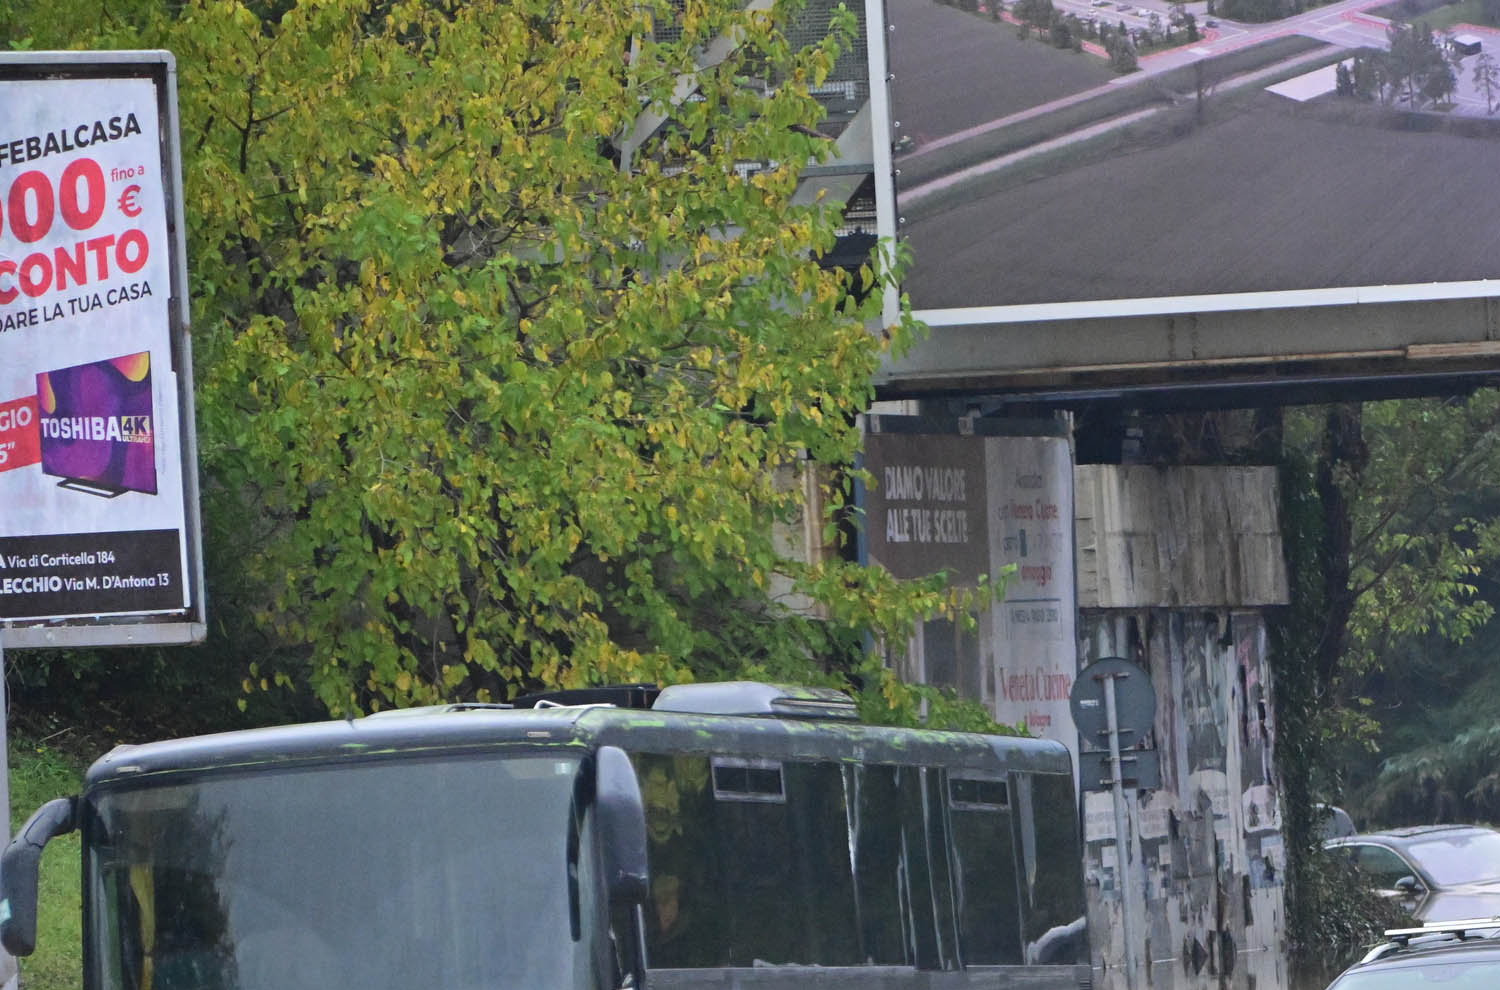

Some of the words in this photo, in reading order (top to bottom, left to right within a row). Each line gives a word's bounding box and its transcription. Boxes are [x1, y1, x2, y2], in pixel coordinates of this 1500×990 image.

[0, 112, 142, 168] FEBALCASA
[110, 167, 135, 182] fino
[137, 165, 145, 176] a
[0, 157, 106, 244] 00
[117, 184, 143, 218] €
[0, 308, 39, 334] ARE
[43, 302, 65, 322] LA
[68, 292, 104, 316] TUA
[107, 281, 153, 306] CASA
[40, 415, 122, 442] TOSHIBA
[123, 416, 149, 435] 4K
[7, 555, 27, 568] Via
[28, 554, 39, 567] di
[40, 551, 96, 567] Corticella
[96, 550, 116, 564] 184
[0, 575, 63, 595] ECCHIO
[63, 577, 85, 592] Via
[85, 576, 101, 590] M.
[102, 575, 156, 589] D'Antona
[157, 572, 170, 586] 13
